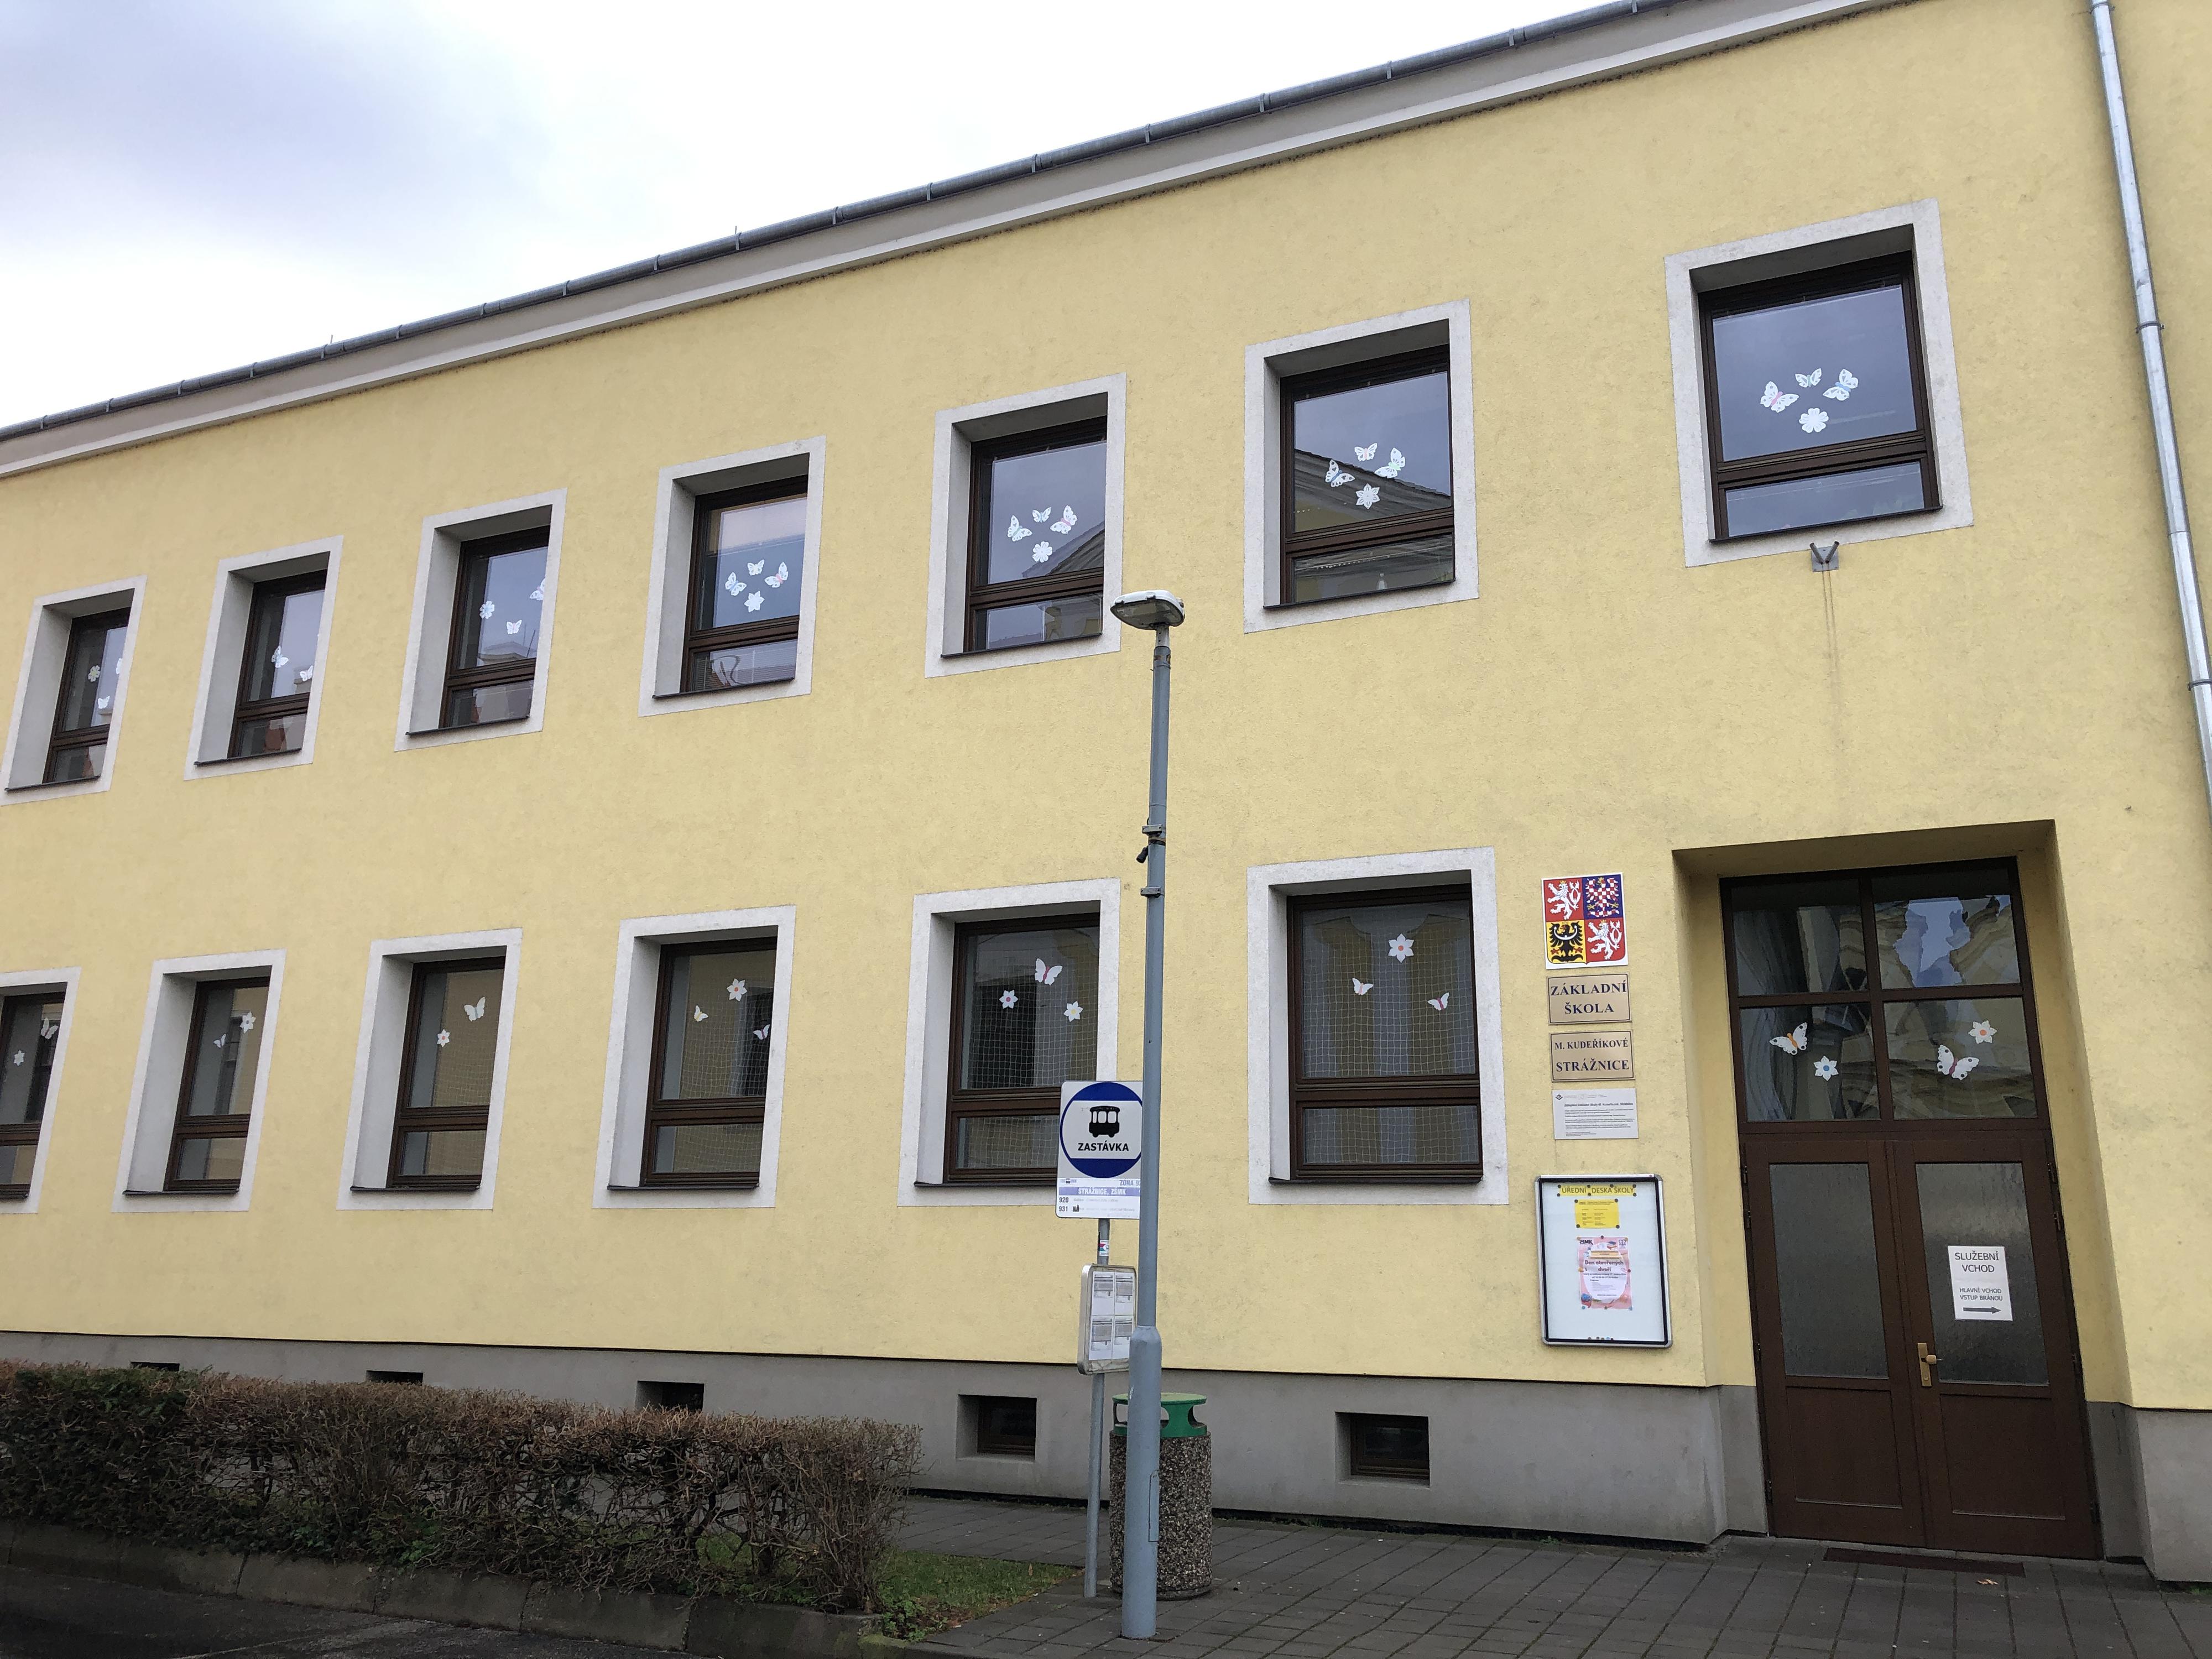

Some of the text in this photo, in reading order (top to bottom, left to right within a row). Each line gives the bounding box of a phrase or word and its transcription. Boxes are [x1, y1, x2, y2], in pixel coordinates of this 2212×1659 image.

[1550, 979, 1627, 996] ZÁKLADNÍ
[1564, 1001, 1614, 1015] ŠKOLA
[1567, 1037, 1629, 1049] KUDEŘÍKOVÉ
[1556, 1058, 1629, 1072] STRÁŽNICE
[1078, 1140, 1129, 1151] ZASTÁVKA
[1955, 1250, 2000, 1261] SLUŽEBNÍ
